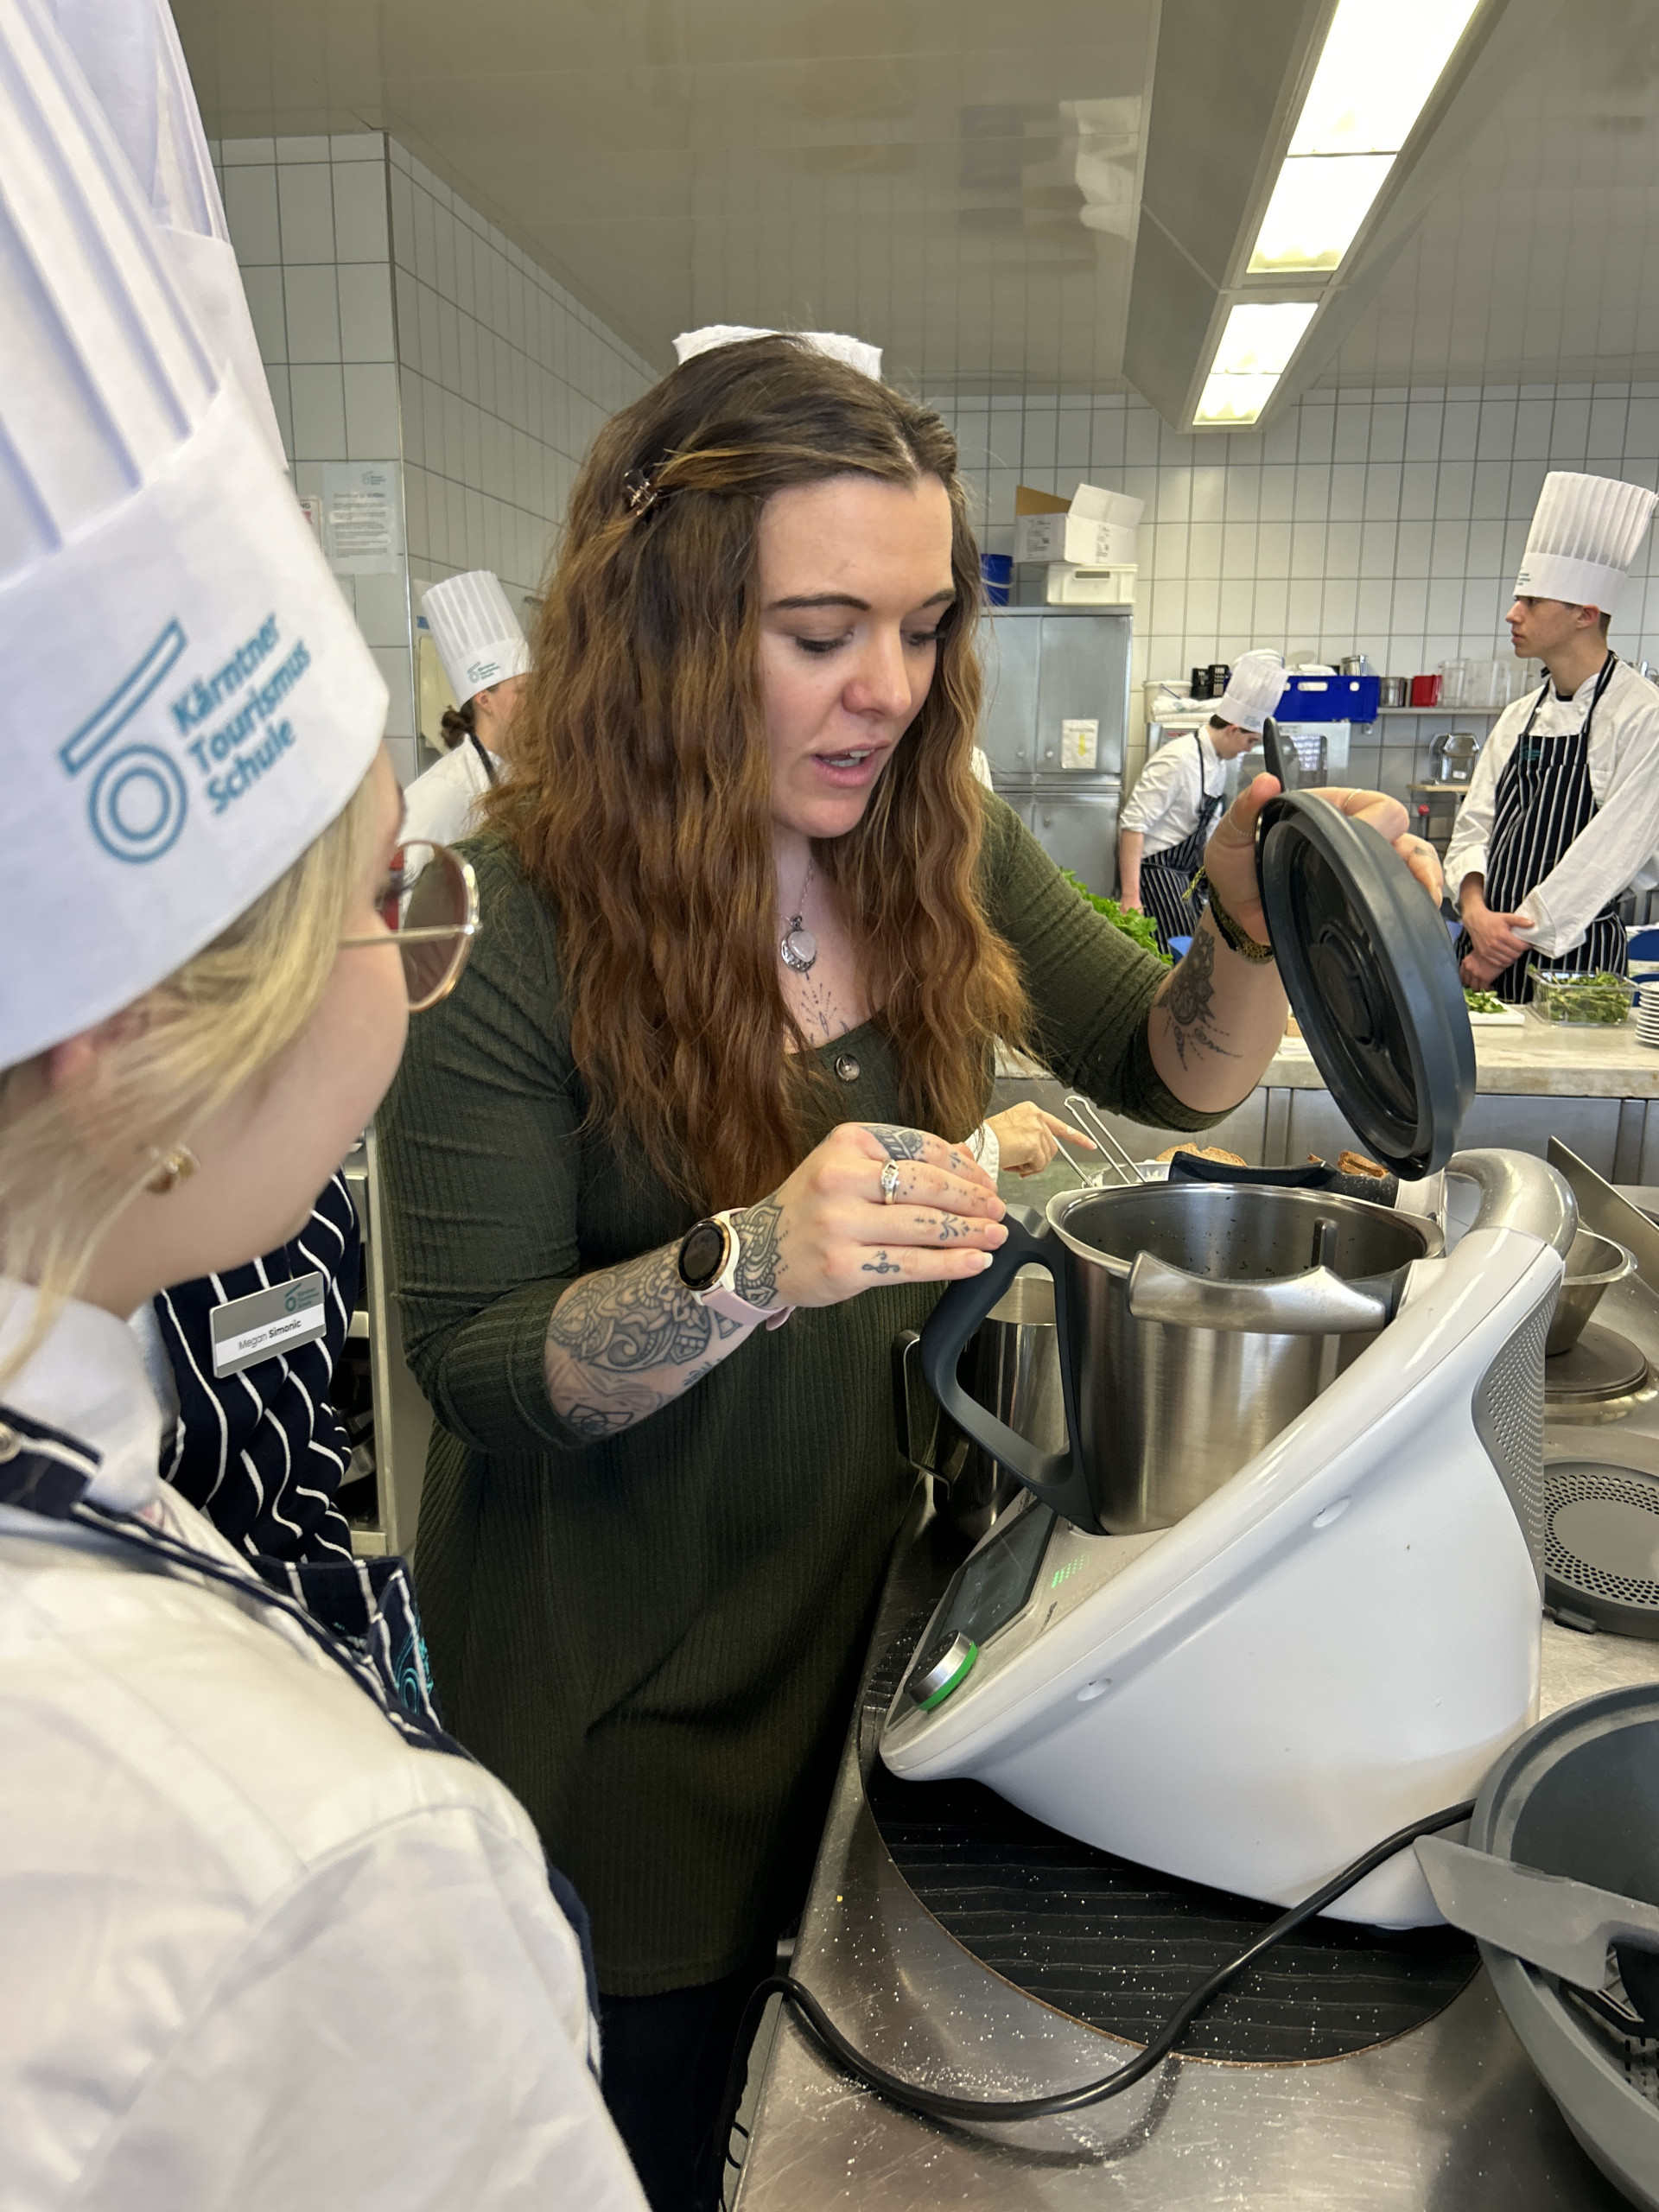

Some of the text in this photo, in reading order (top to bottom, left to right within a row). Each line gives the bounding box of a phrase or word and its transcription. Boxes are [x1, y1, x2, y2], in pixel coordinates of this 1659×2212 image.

[172, 612, 279, 734] Kärntner
[188, 639, 311, 773] Tourismus
[206, 720, 295, 814] Schule
[238, 1333, 268, 1351] Megan
